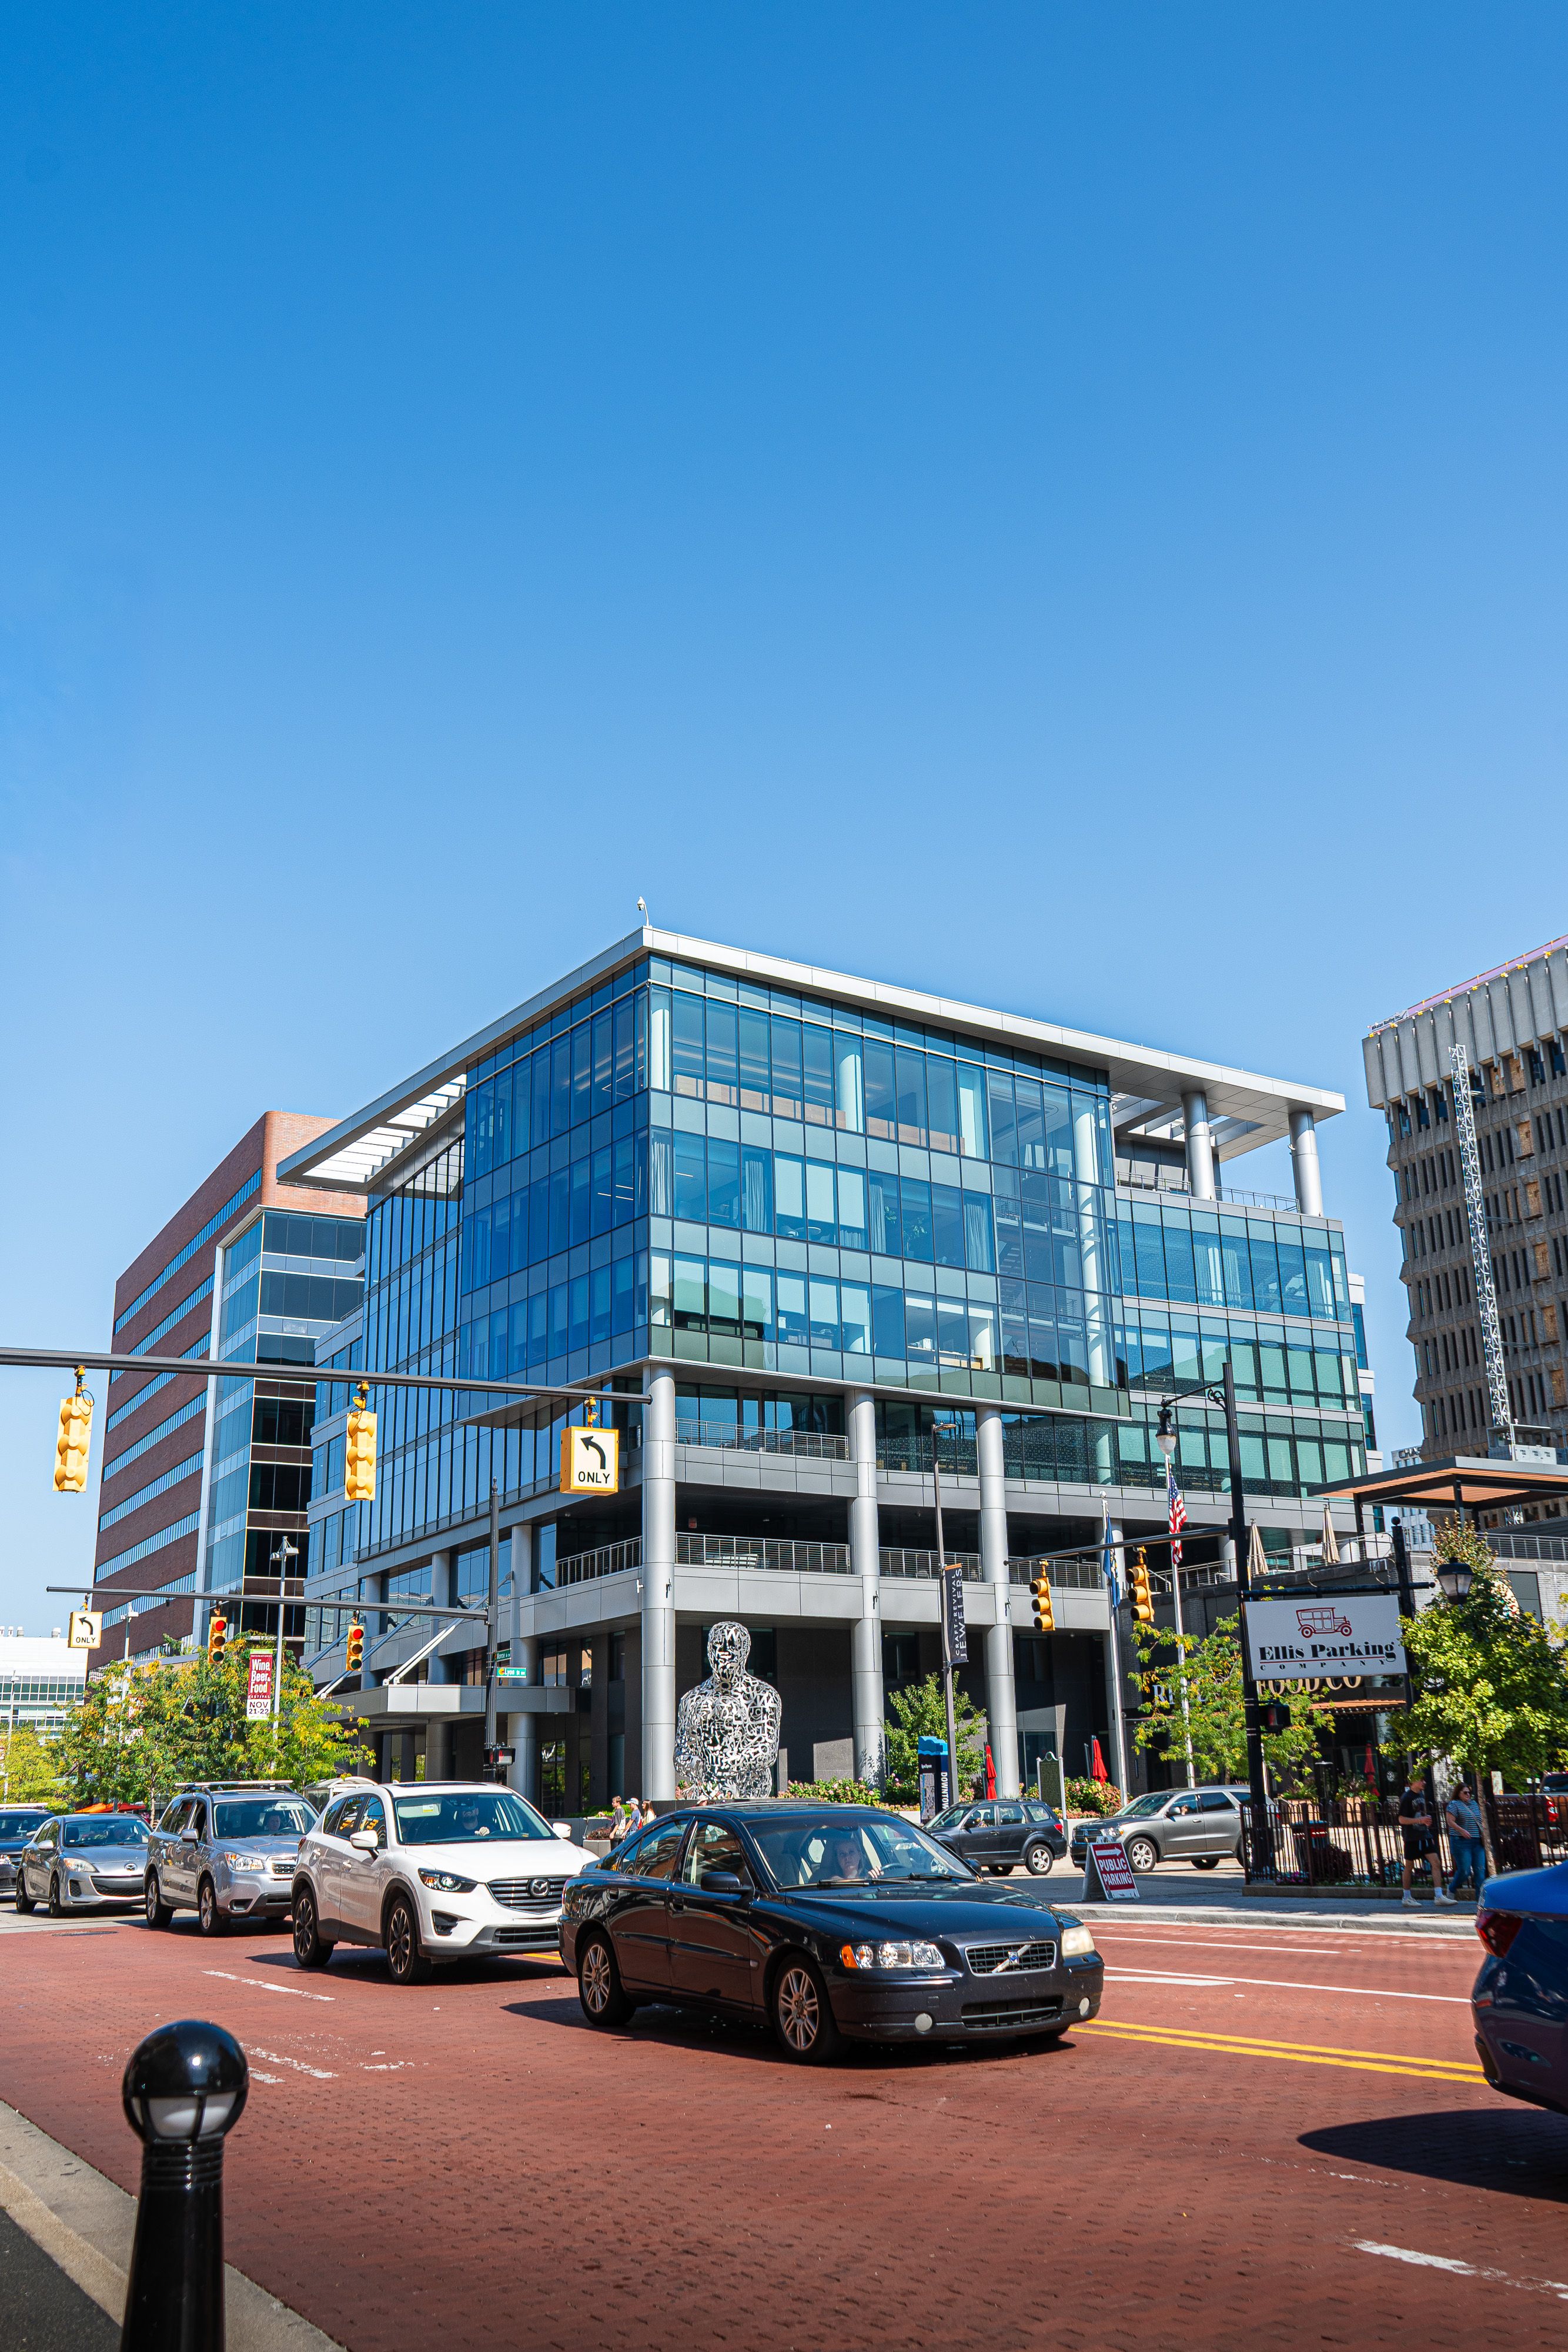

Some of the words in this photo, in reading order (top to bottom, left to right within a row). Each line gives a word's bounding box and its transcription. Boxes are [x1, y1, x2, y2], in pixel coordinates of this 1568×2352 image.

[579, 1471, 610, 1484] ONLY
[952, 1574, 960, 1655] CRAFT-REVIVAL
[1258, 1645, 1305, 1661] Ellis
[1310, 1641, 1396, 1662] Parking
[252, 1659, 270, 1671] Wine,
[1260, 1659, 1386, 1671] COMPANY
[504, 1668, 515, 1676] Lyon
[250, 1681, 268, 1693] Food
[941, 1772, 949, 1810] DOWNTOW
[1098, 1857, 1127, 1872] PUBLIC
[1102, 1872, 1133, 1885] PARKING
